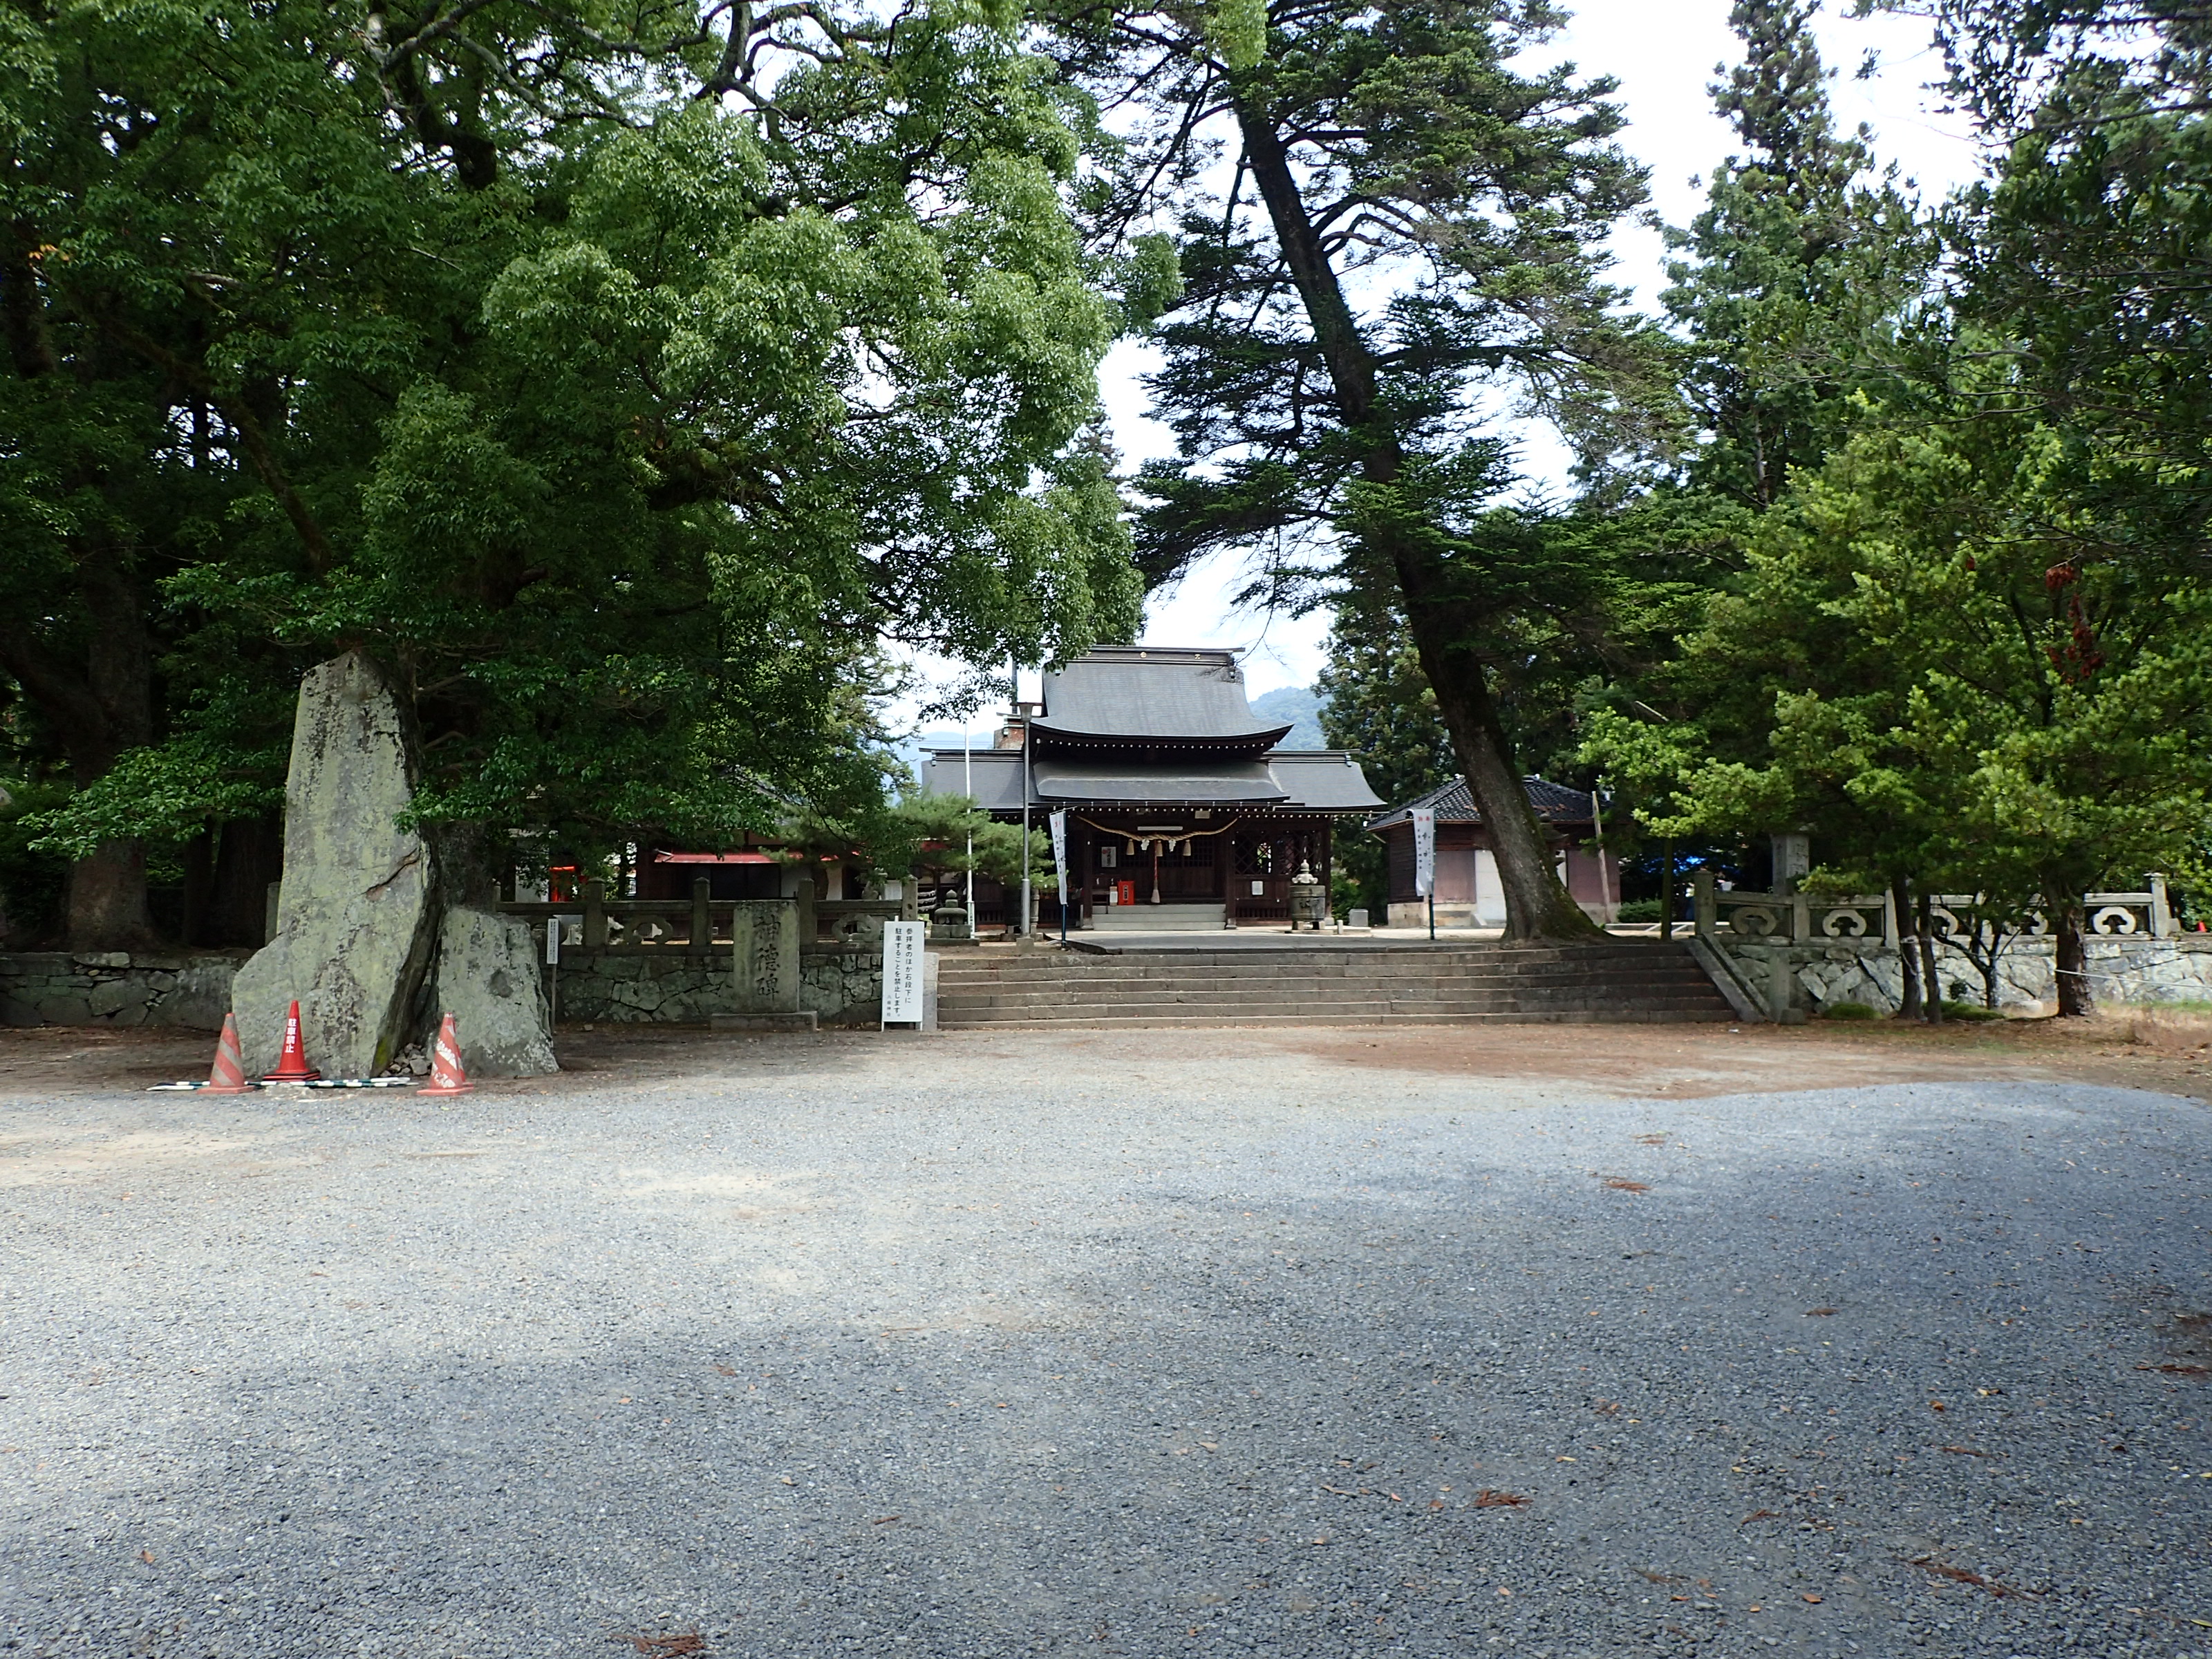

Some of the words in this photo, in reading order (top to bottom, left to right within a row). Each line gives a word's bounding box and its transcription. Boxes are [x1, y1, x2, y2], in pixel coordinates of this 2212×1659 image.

[894, 928, 903, 1017] 駐車することを禁止します。
[905, 928, 913, 1003] 参拝者のほか石段下に
[285, 1018, 297, 1053] 駐車禁止
